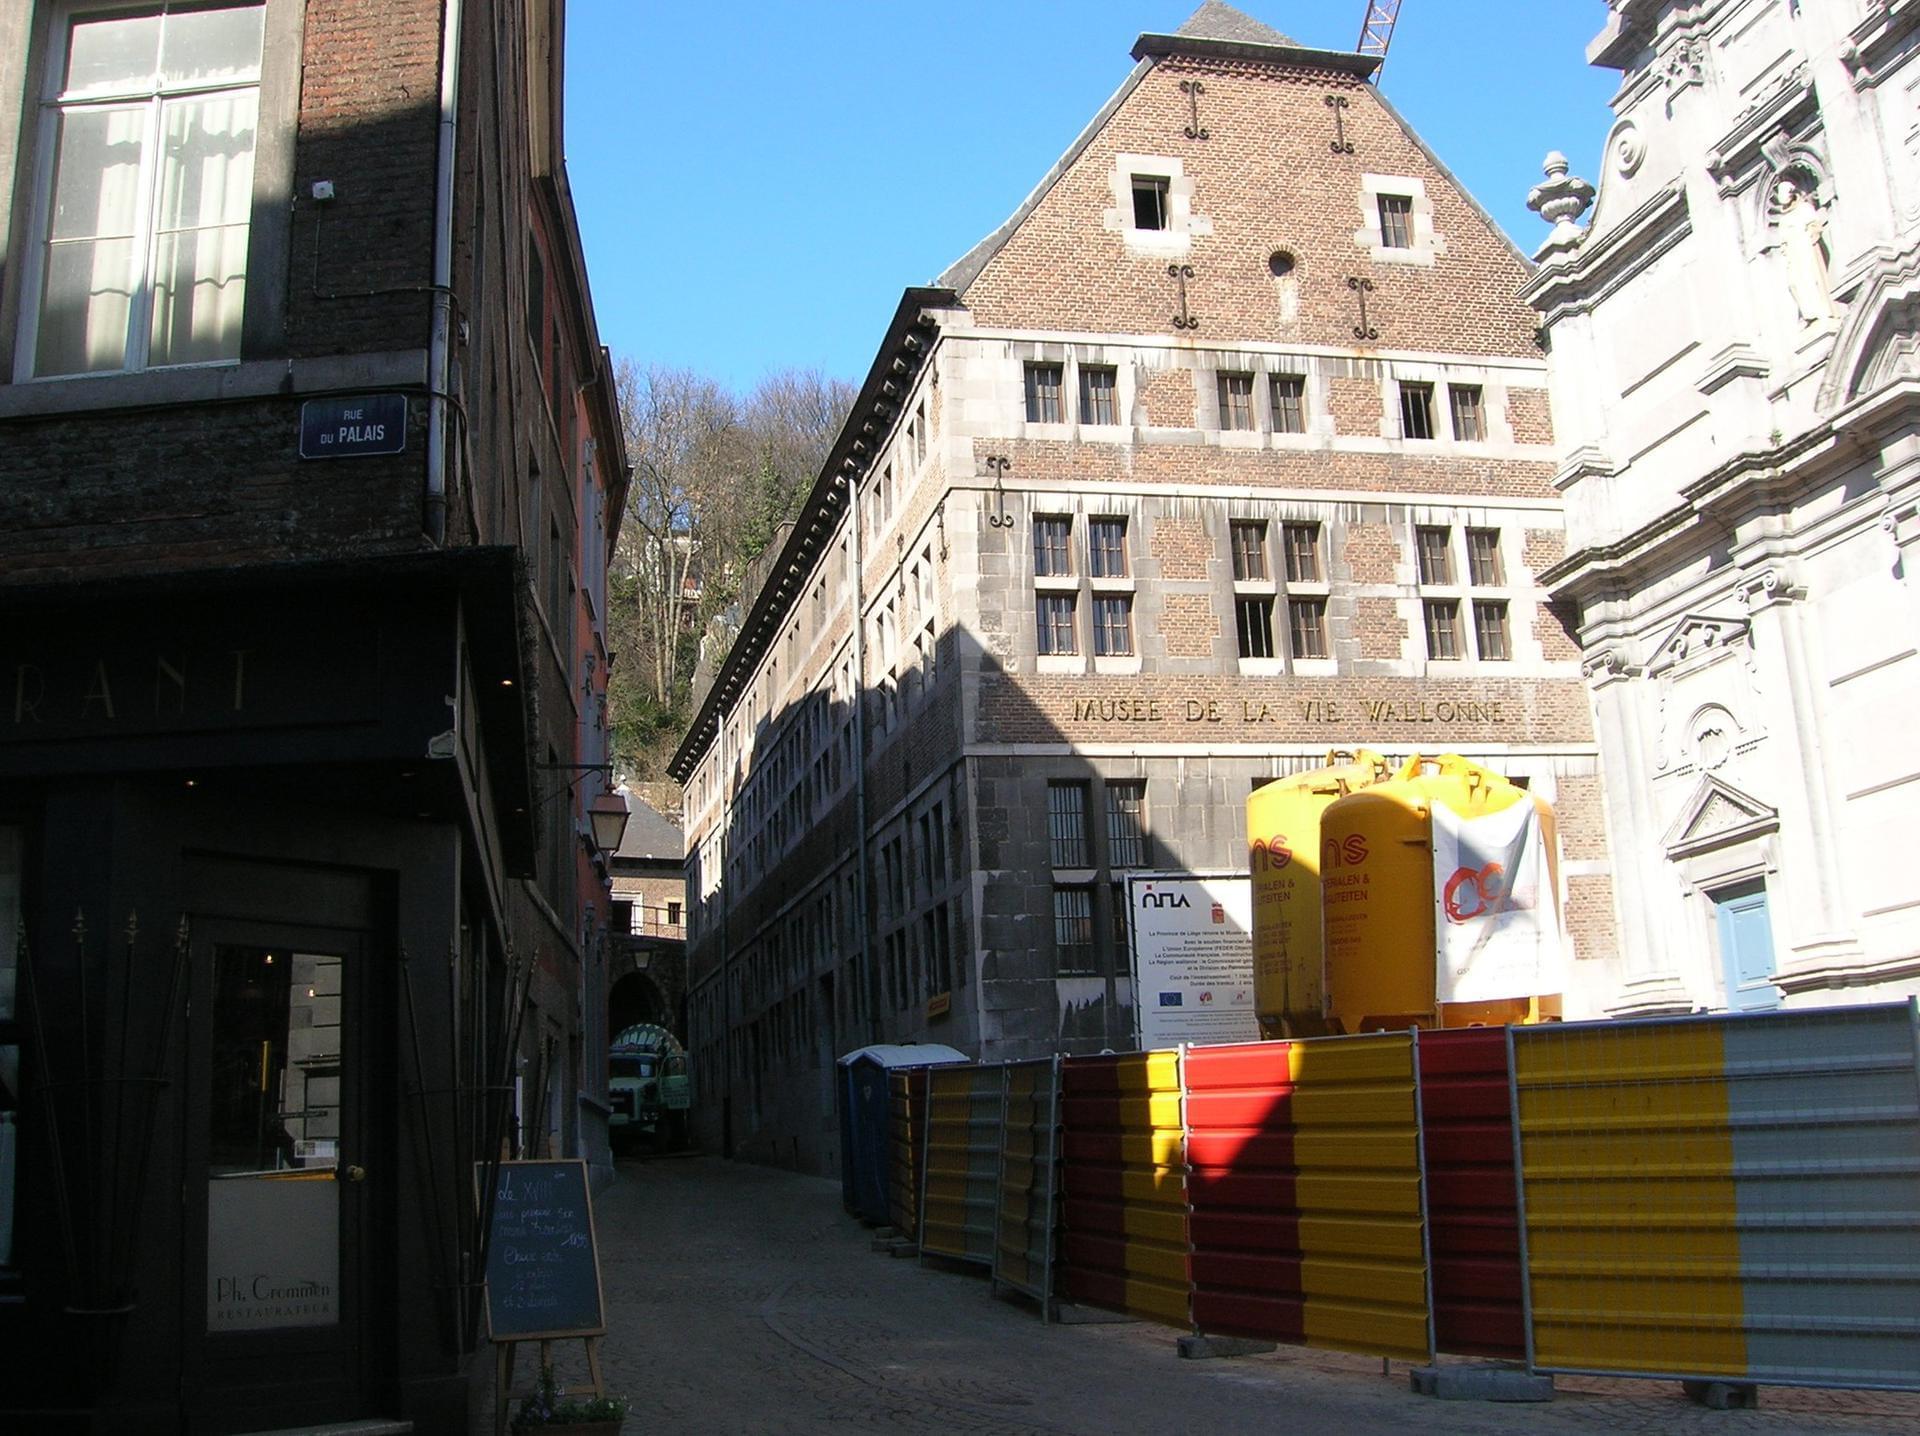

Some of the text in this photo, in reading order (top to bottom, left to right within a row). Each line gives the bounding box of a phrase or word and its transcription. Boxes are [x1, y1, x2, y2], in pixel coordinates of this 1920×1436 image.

[343, 409, 364, 421] RUE
[320, 425, 385, 445] DU PALAIS
[1185, 700, 1221, 722] DE
[1243, 701, 1275, 722] LA
[1297, 700, 1342, 722] VIE
[1359, 700, 1505, 723] WALLONNE
[218, 1303, 329, 1320] RESTAURATEUR
